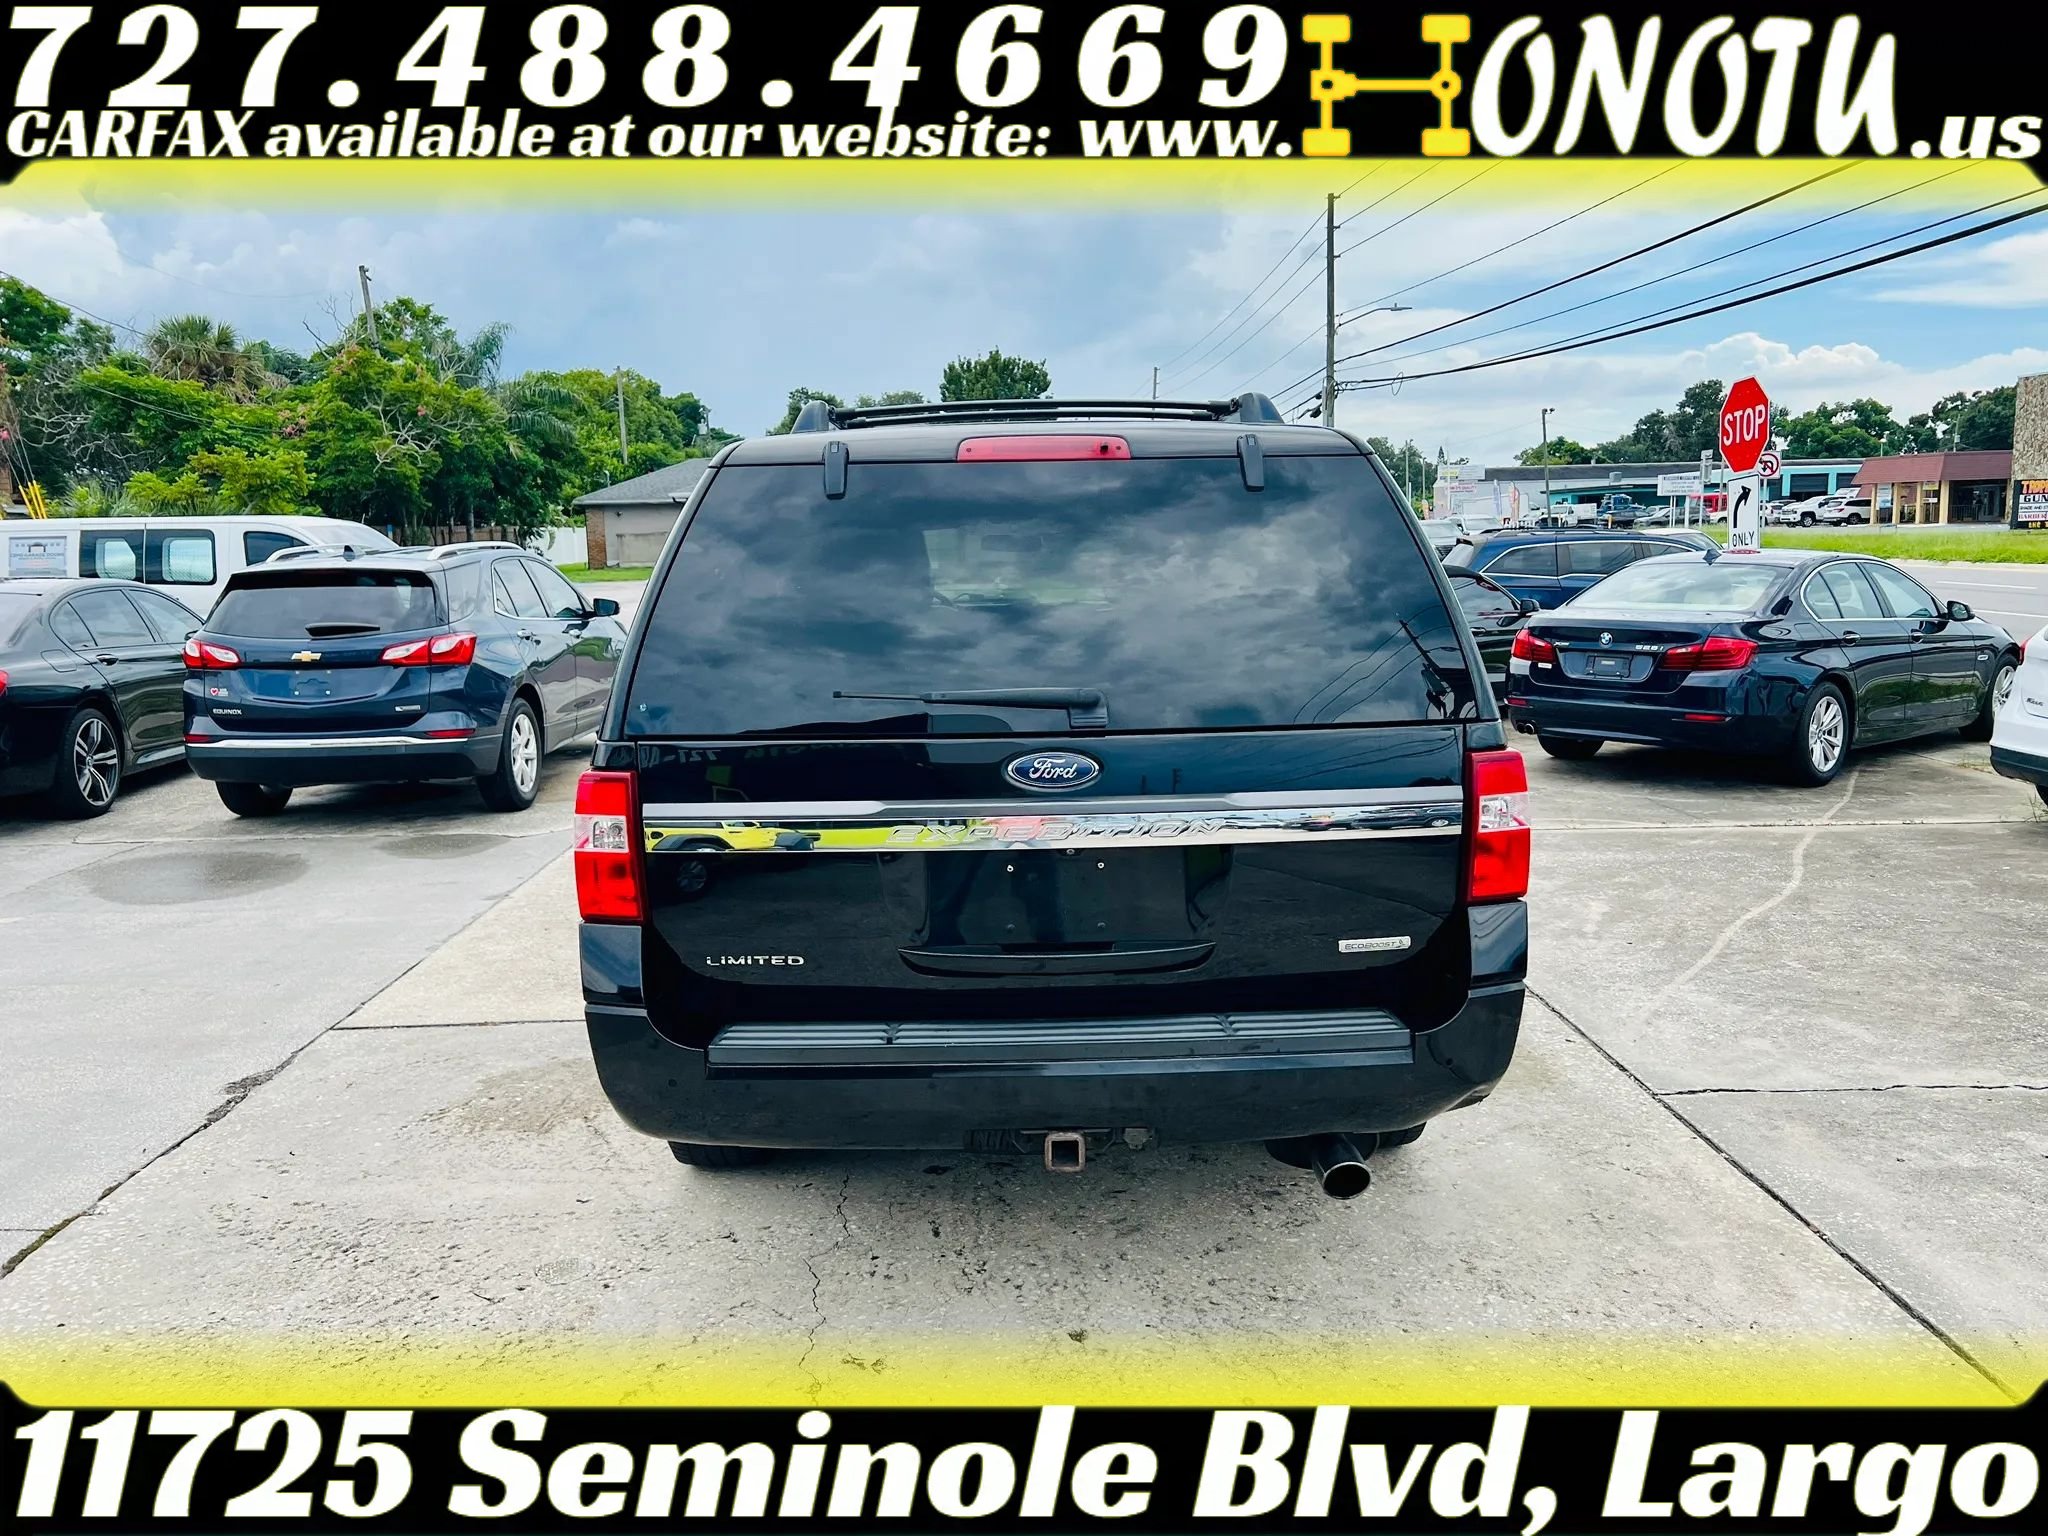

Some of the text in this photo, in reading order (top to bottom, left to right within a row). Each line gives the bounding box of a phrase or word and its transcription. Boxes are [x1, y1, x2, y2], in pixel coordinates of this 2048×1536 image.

[1723, 404, 1766, 446] STOP
[1732, 531, 1755, 547] ONLY
[1028, 757, 1078, 780] Ford
[886, 817, 1231, 844] EXPEDITION
[1344, 941, 1397, 950] ECOBOOST
[705, 955, 805, 966] LIMITED
